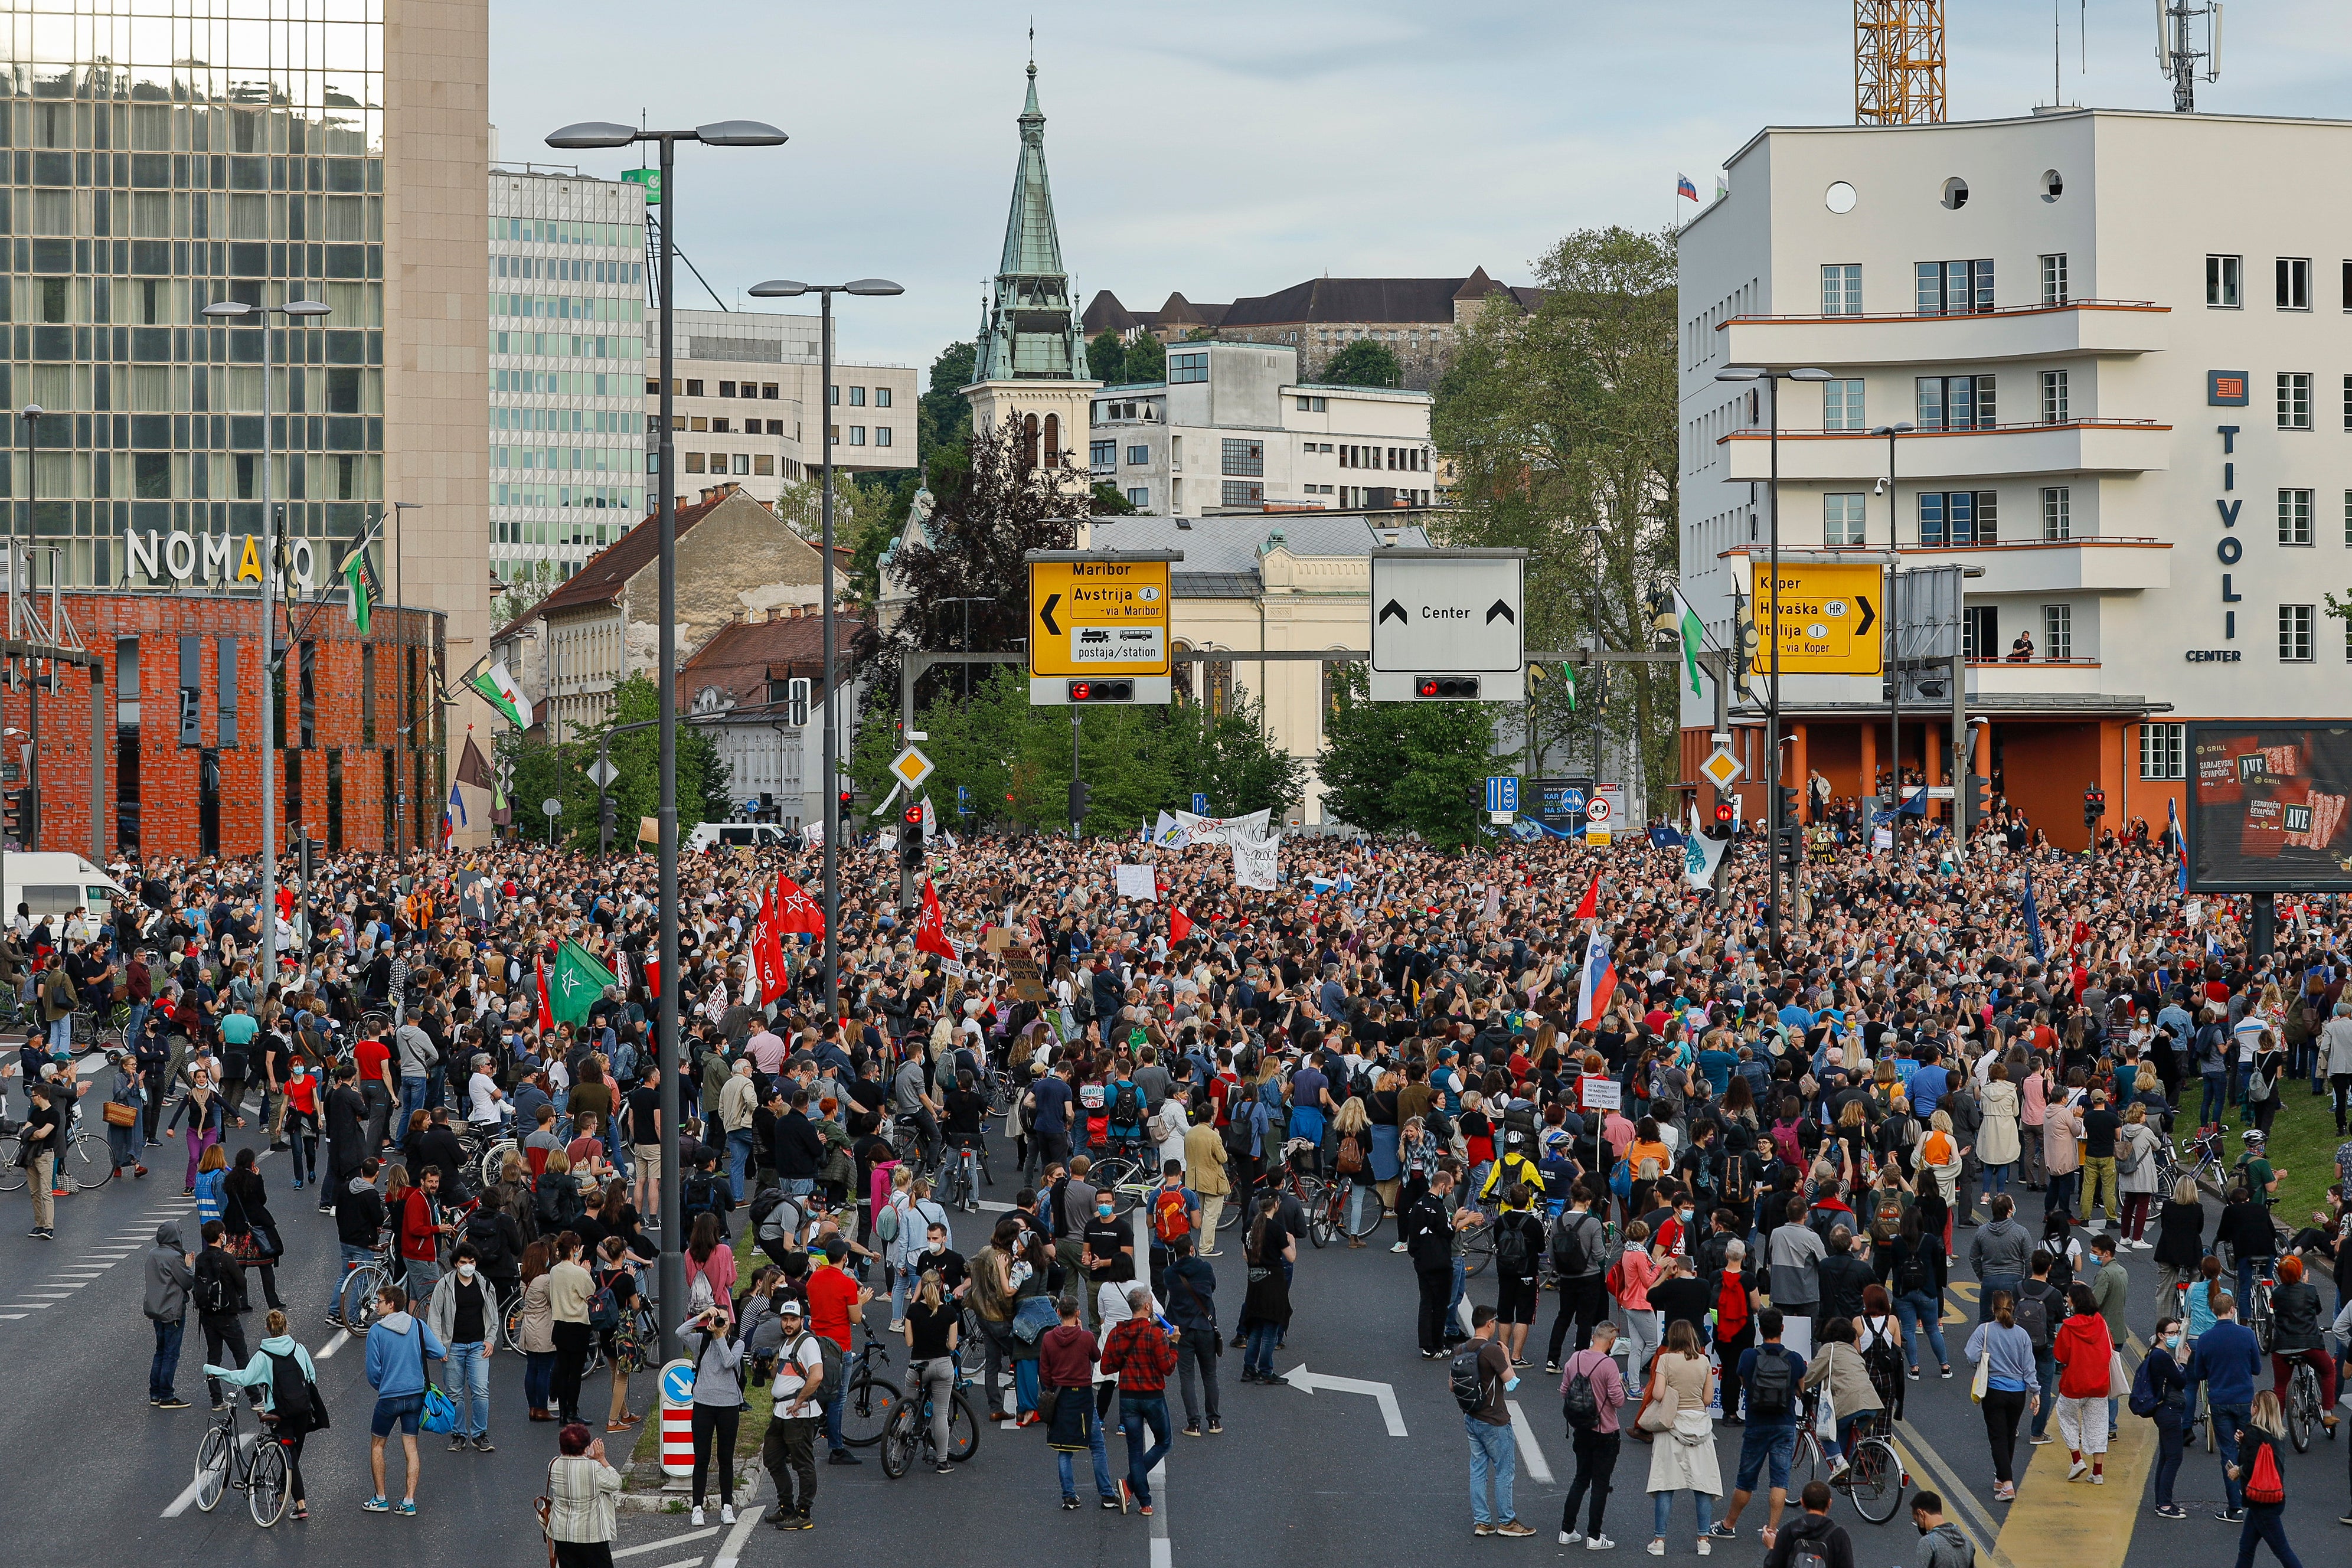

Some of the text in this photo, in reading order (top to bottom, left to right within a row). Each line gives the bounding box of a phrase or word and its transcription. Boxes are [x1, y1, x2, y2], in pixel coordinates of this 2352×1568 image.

[2216, 426, 2243, 639] TIVOLI
[1073, 563, 1131, 576] Maribor
[1760, 576, 1801, 592] Kper
[1074, 587, 1152, 603] Avstrija A
[1125, 605, 1159, 616] Maribor
[1422, 606, 1471, 619] Center
[1760, 602, 1842, 615] Hvaška HR
[1760, 624, 1801, 639] Itlija
[1079, 645, 1156, 659] postaja/station
[1804, 642, 1830, 655] Koper
[2186, 649, 2242, 662] CENTER
[2199, 759, 2234, 769] SARAJEVSKI
[2250, 800, 2282, 809] LESKOVAČKI
[2286, 809, 2309, 829] AVE
[1007, 959, 1034, 969] NEVIDNO
[1011, 970, 1026, 979] ROKO
